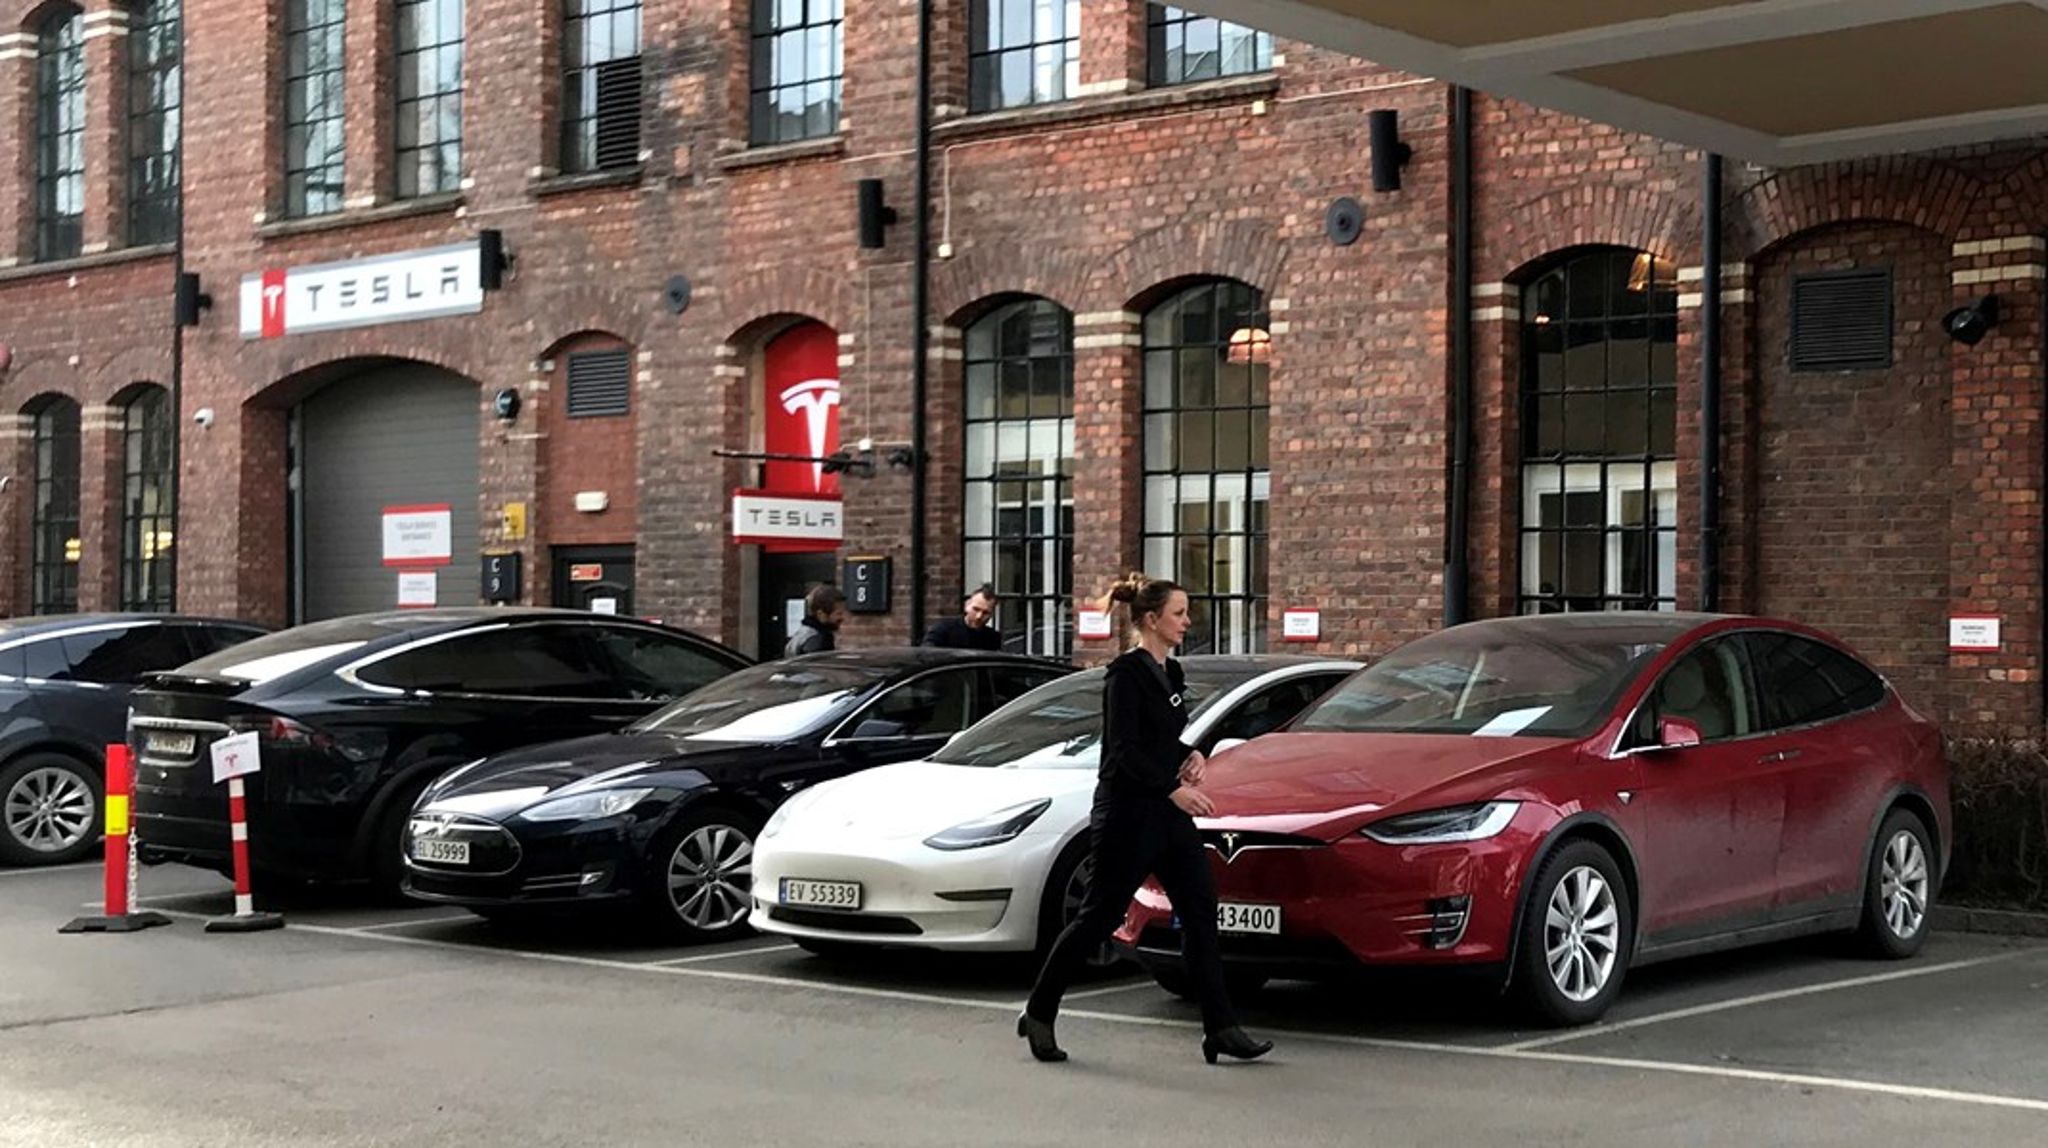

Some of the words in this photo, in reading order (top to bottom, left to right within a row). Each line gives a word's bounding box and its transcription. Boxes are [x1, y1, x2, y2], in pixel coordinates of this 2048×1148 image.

[306, 265, 459, 312] TESLA
[748, 508, 836, 527] TESLA
[491, 558, 501, 573] C
[856, 564, 867, 581] C
[491, 578, 501, 592] 9
[856, 587, 867, 602] 8
[431, 842, 466, 860] 25999
[789, 882, 805, 900] EV
[810, 883, 856, 904] 55339
